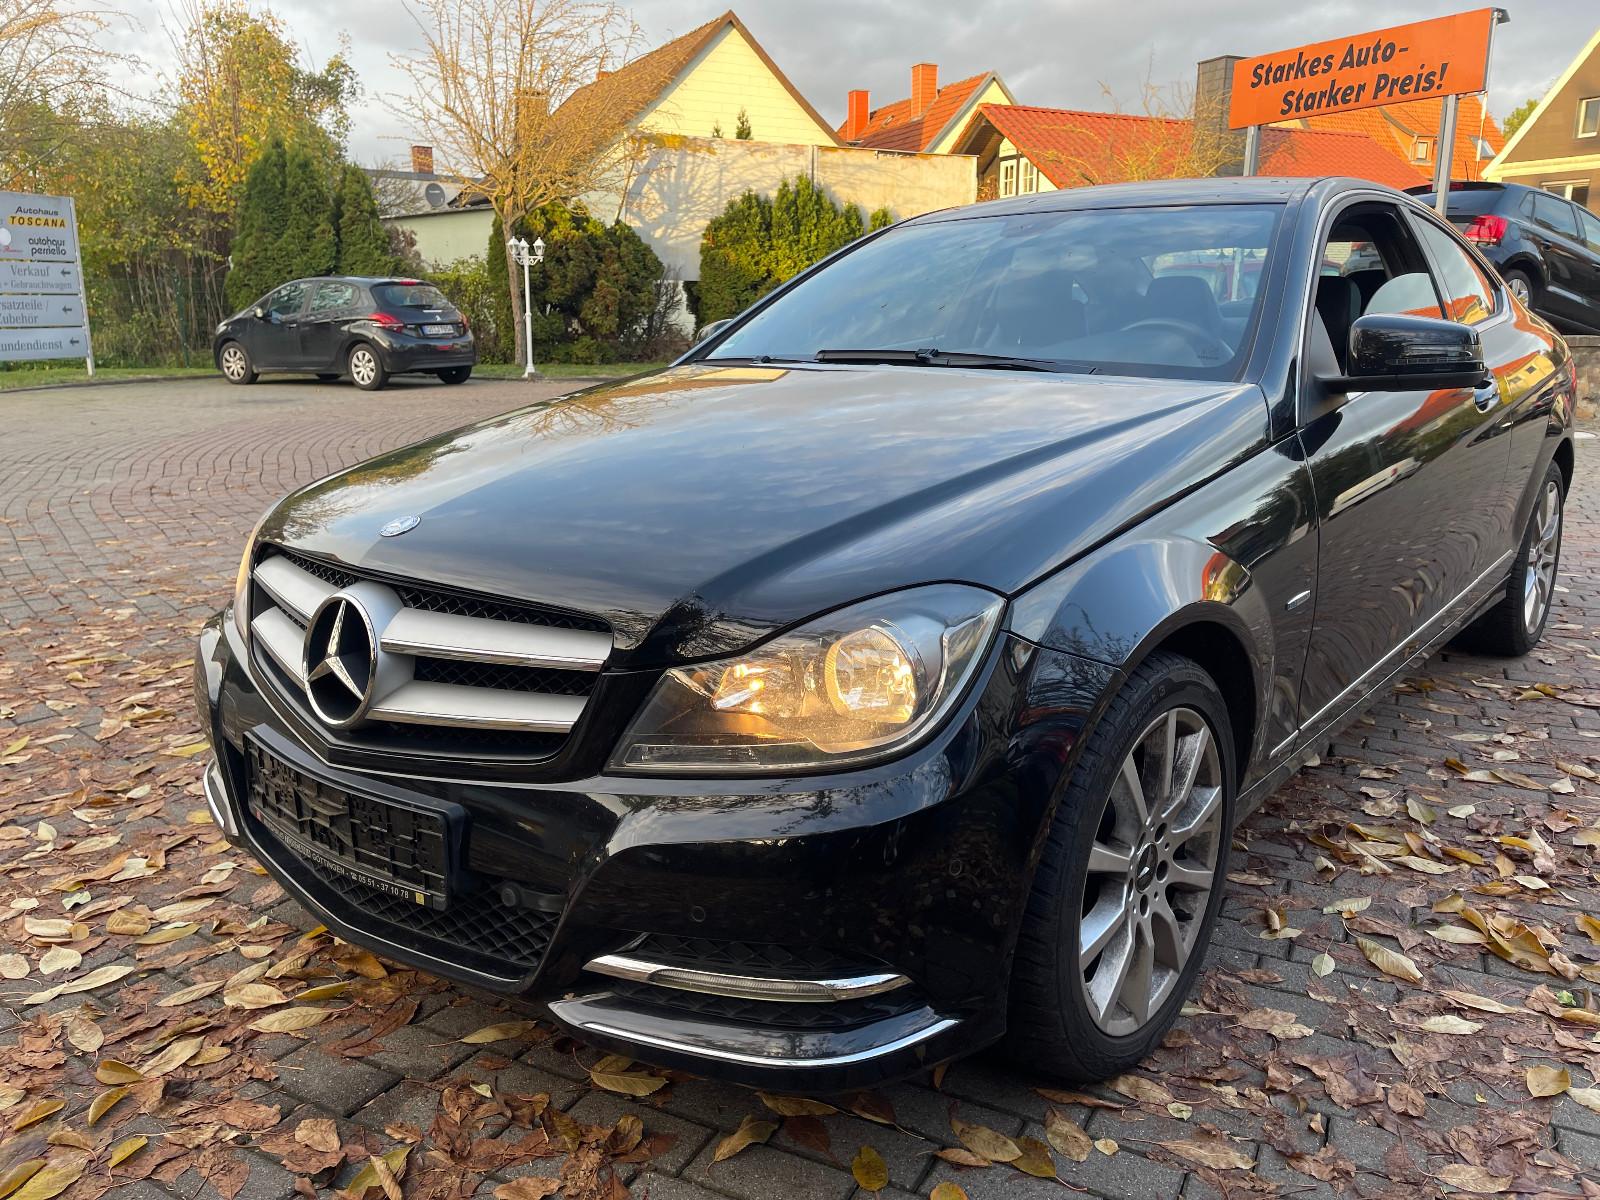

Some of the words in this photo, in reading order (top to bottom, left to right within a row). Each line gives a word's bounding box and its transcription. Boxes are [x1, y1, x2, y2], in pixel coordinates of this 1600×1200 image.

[1250, 51, 1335, 89] Starkes
[1337, 38, 1409, 71] Auto-
[1280, 79, 1367, 116] Starker
[1372, 62, 1449, 100] Preis!
[15, 206, 59, 216] Autohaus
[10, 216, 66, 228] TOSCANA
[10, 264, 50, 277] Verkauf
[10, 279, 72, 291] Gebrauchtwagen
[0, 300, 43, 311] satzteile
[0, 340, 64, 352] undendienst
[312, 853, 345, 876] GÖTTINGEN
[359, 875, 366, 884] 05
[367, 878, 376, 887] 51
[380, 883, 389, 891] 37
[391, 886, 399, 896] 10
